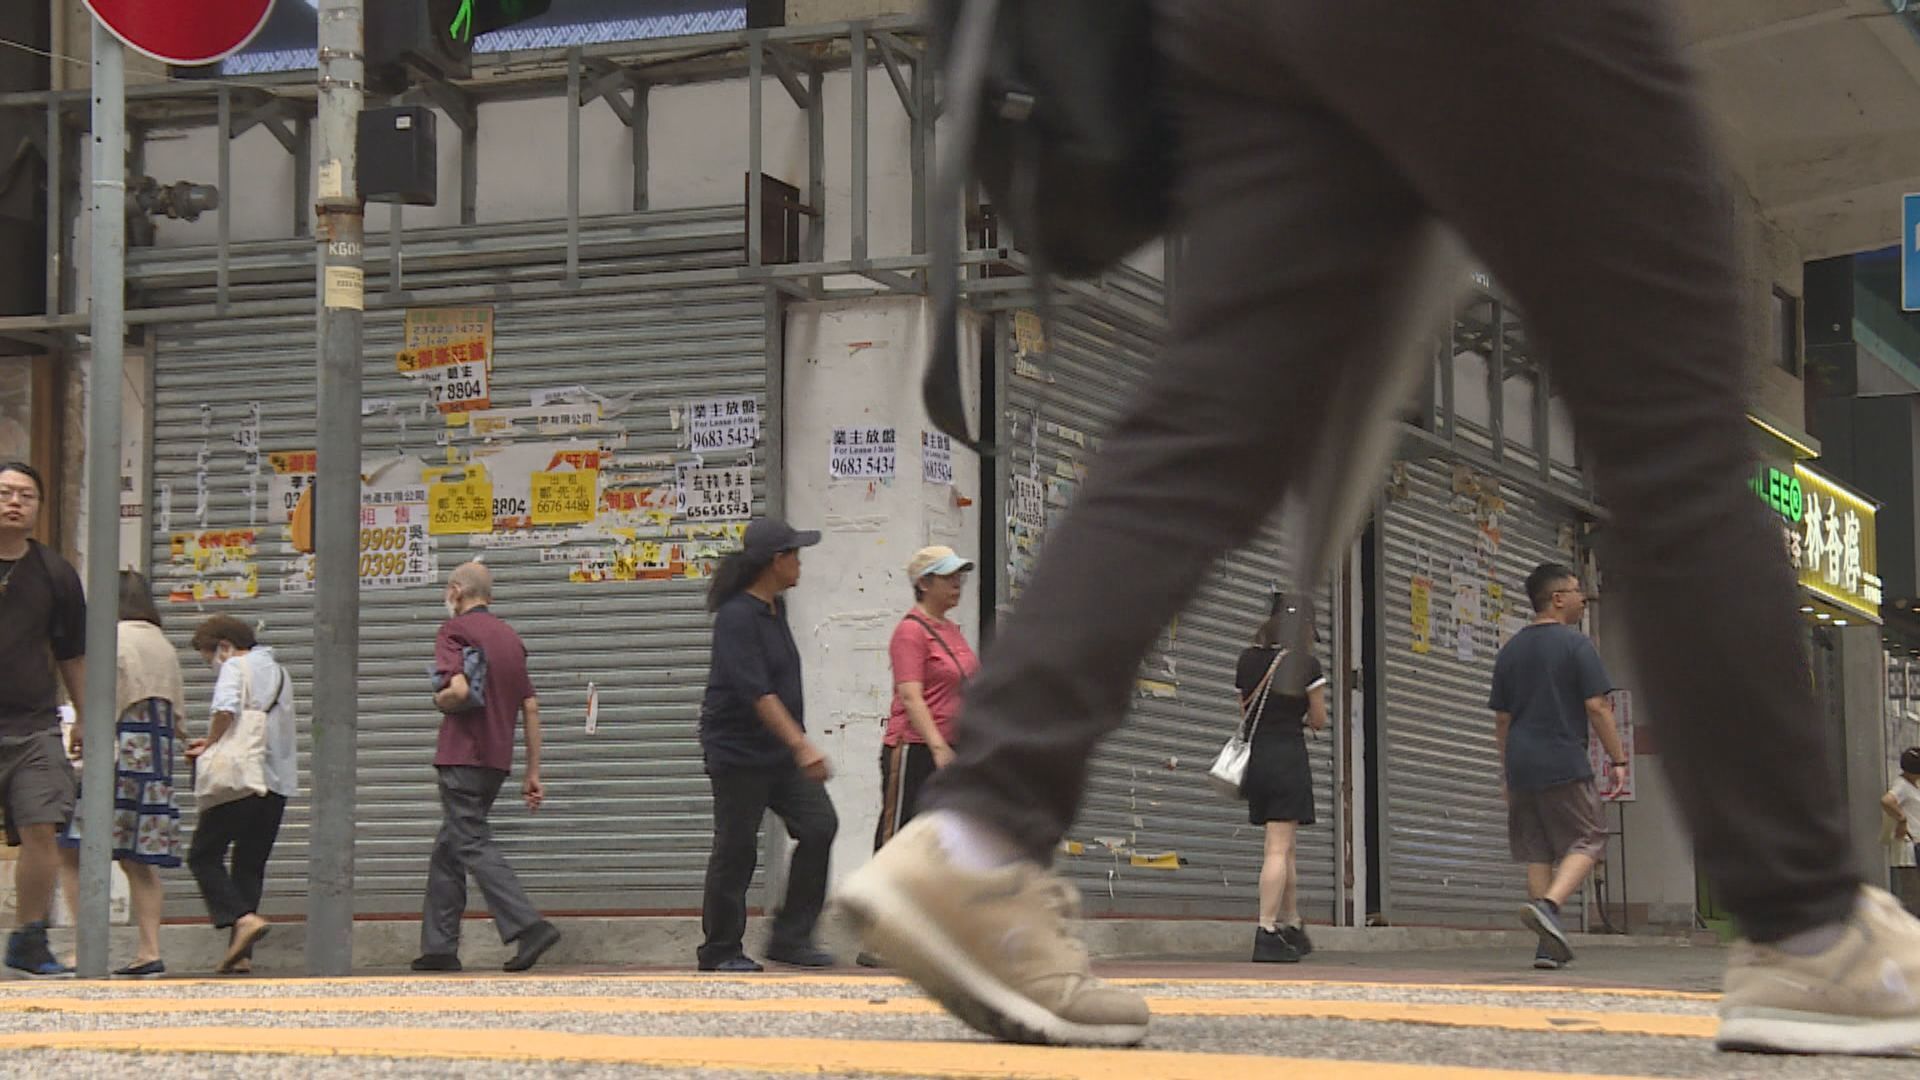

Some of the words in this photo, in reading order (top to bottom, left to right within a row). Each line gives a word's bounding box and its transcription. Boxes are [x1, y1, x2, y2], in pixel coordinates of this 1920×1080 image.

[447, 380, 481, 399] 8804
[694, 400, 755, 418] 業主放盤
[710, 419, 732, 427] Lease
[694, 430, 723, 448] 9683
[833, 428, 896, 445] 業主放盤
[834, 446, 848, 454] For
[850, 446, 872, 454] Lease
[878, 444, 895, 453] Sale
[832, 456, 862, 475] 9683
[866, 456, 895, 475] 5434
[537, 500, 562, 513] 6676
[565, 499, 590, 512] 4489
[687, 501, 749, 517] 65656543
[435, 510, 460, 523] 6676
[462, 510, 487, 522] 4489
[360, 526, 407, 552] 9966
[359, 552, 407, 577] 0396
